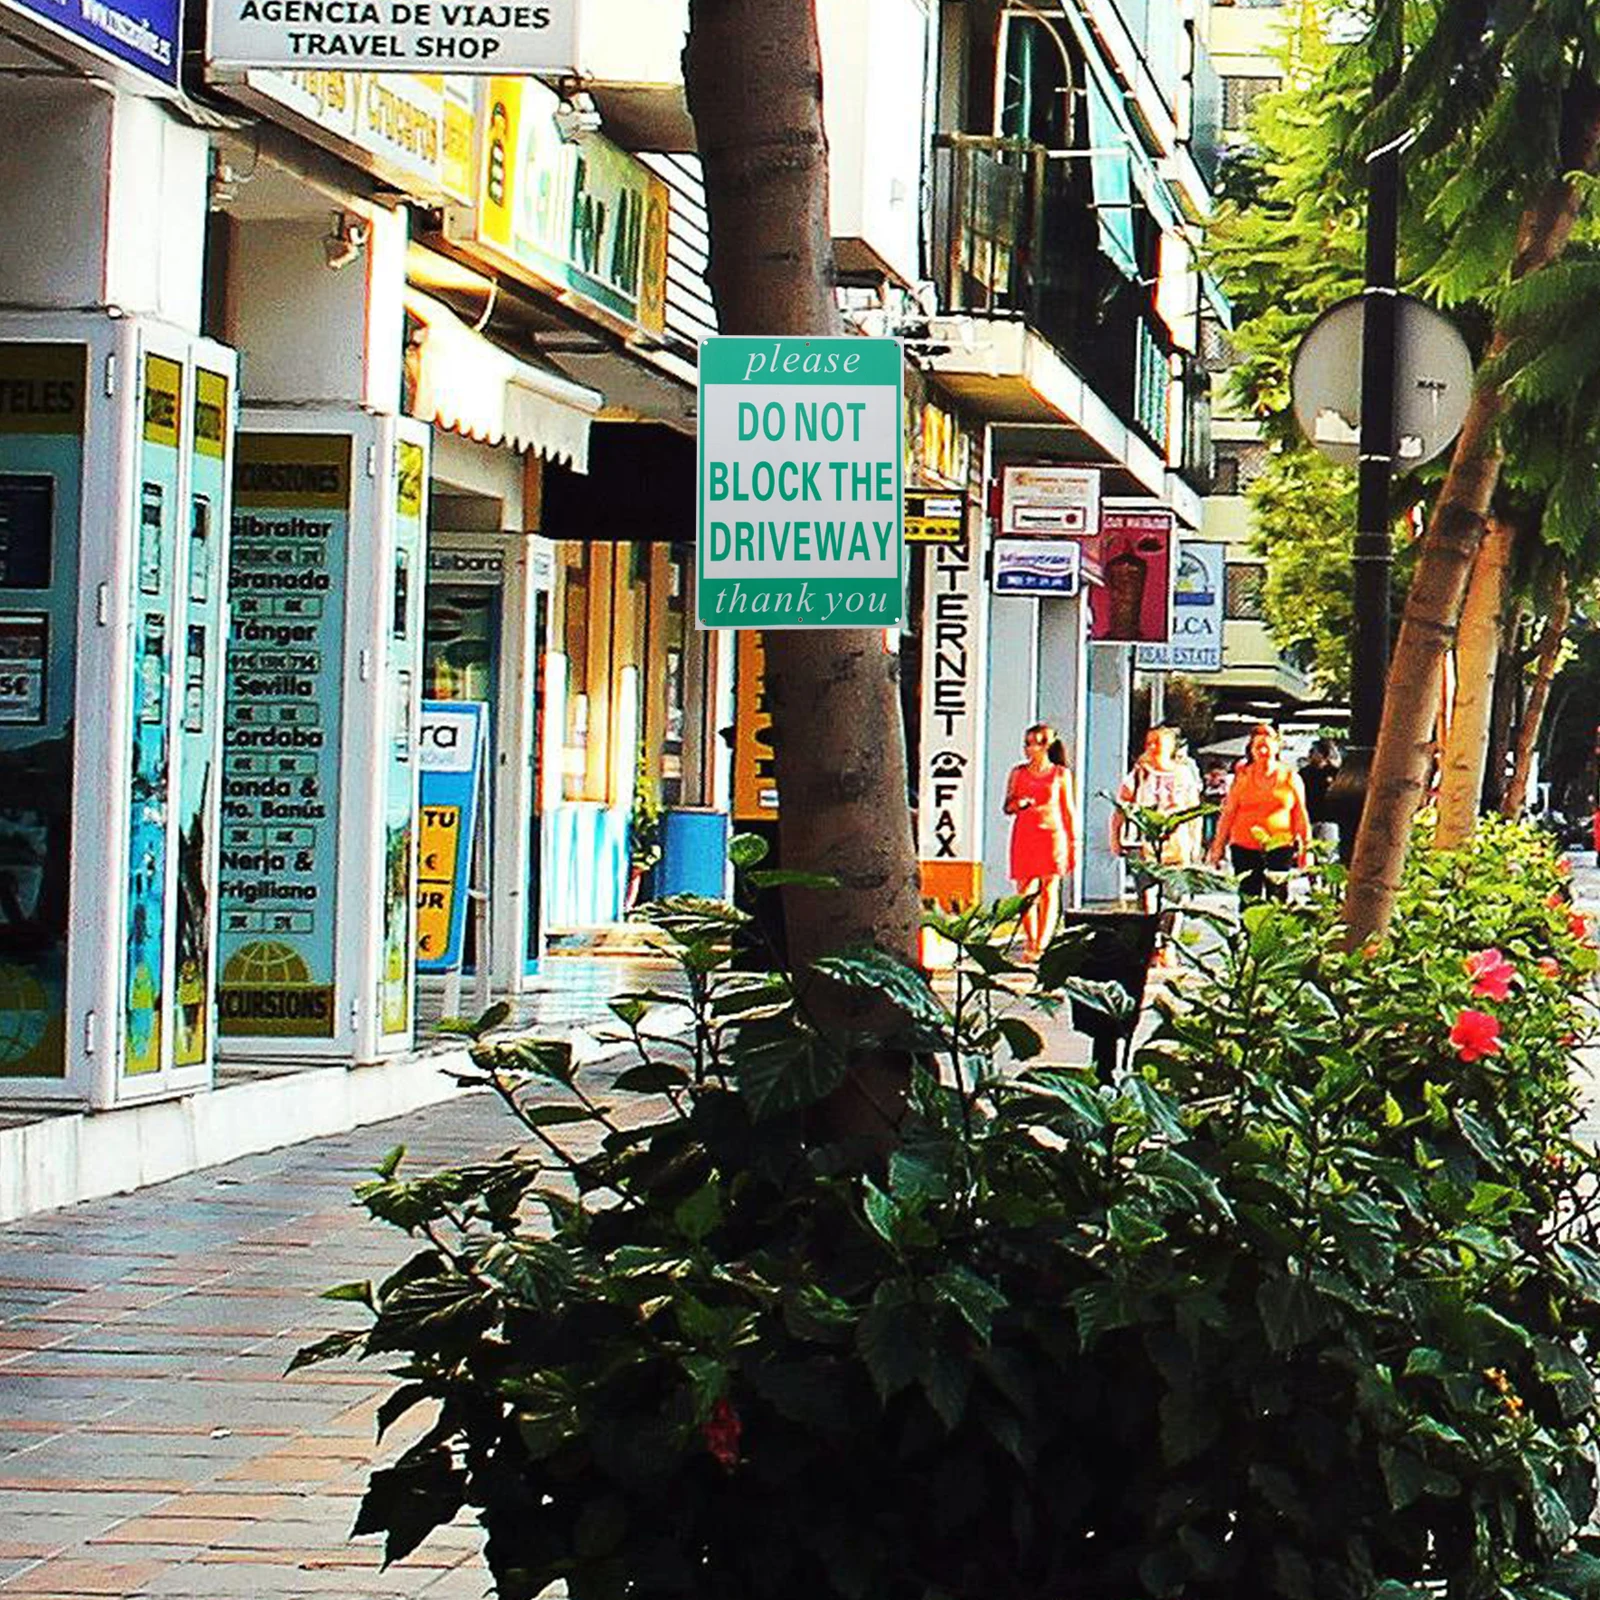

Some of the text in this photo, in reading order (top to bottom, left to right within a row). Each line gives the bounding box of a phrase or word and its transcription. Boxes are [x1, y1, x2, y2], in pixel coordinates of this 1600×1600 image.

[240, 0, 551, 29] AGENCIA DE VIAJES
[289, 32, 499, 60] TRAVEL SHOP
[742, 344, 861, 381] please
[738, 401, 867, 442] DO NOT
[709, 461, 893, 502] BLOCK THE
[709, 521, 894, 562] DRIVEWAY
[715, 582, 888, 621] thank you
[235, 674, 313, 696] Sevilla
[935, 784, 958, 859] FAX
